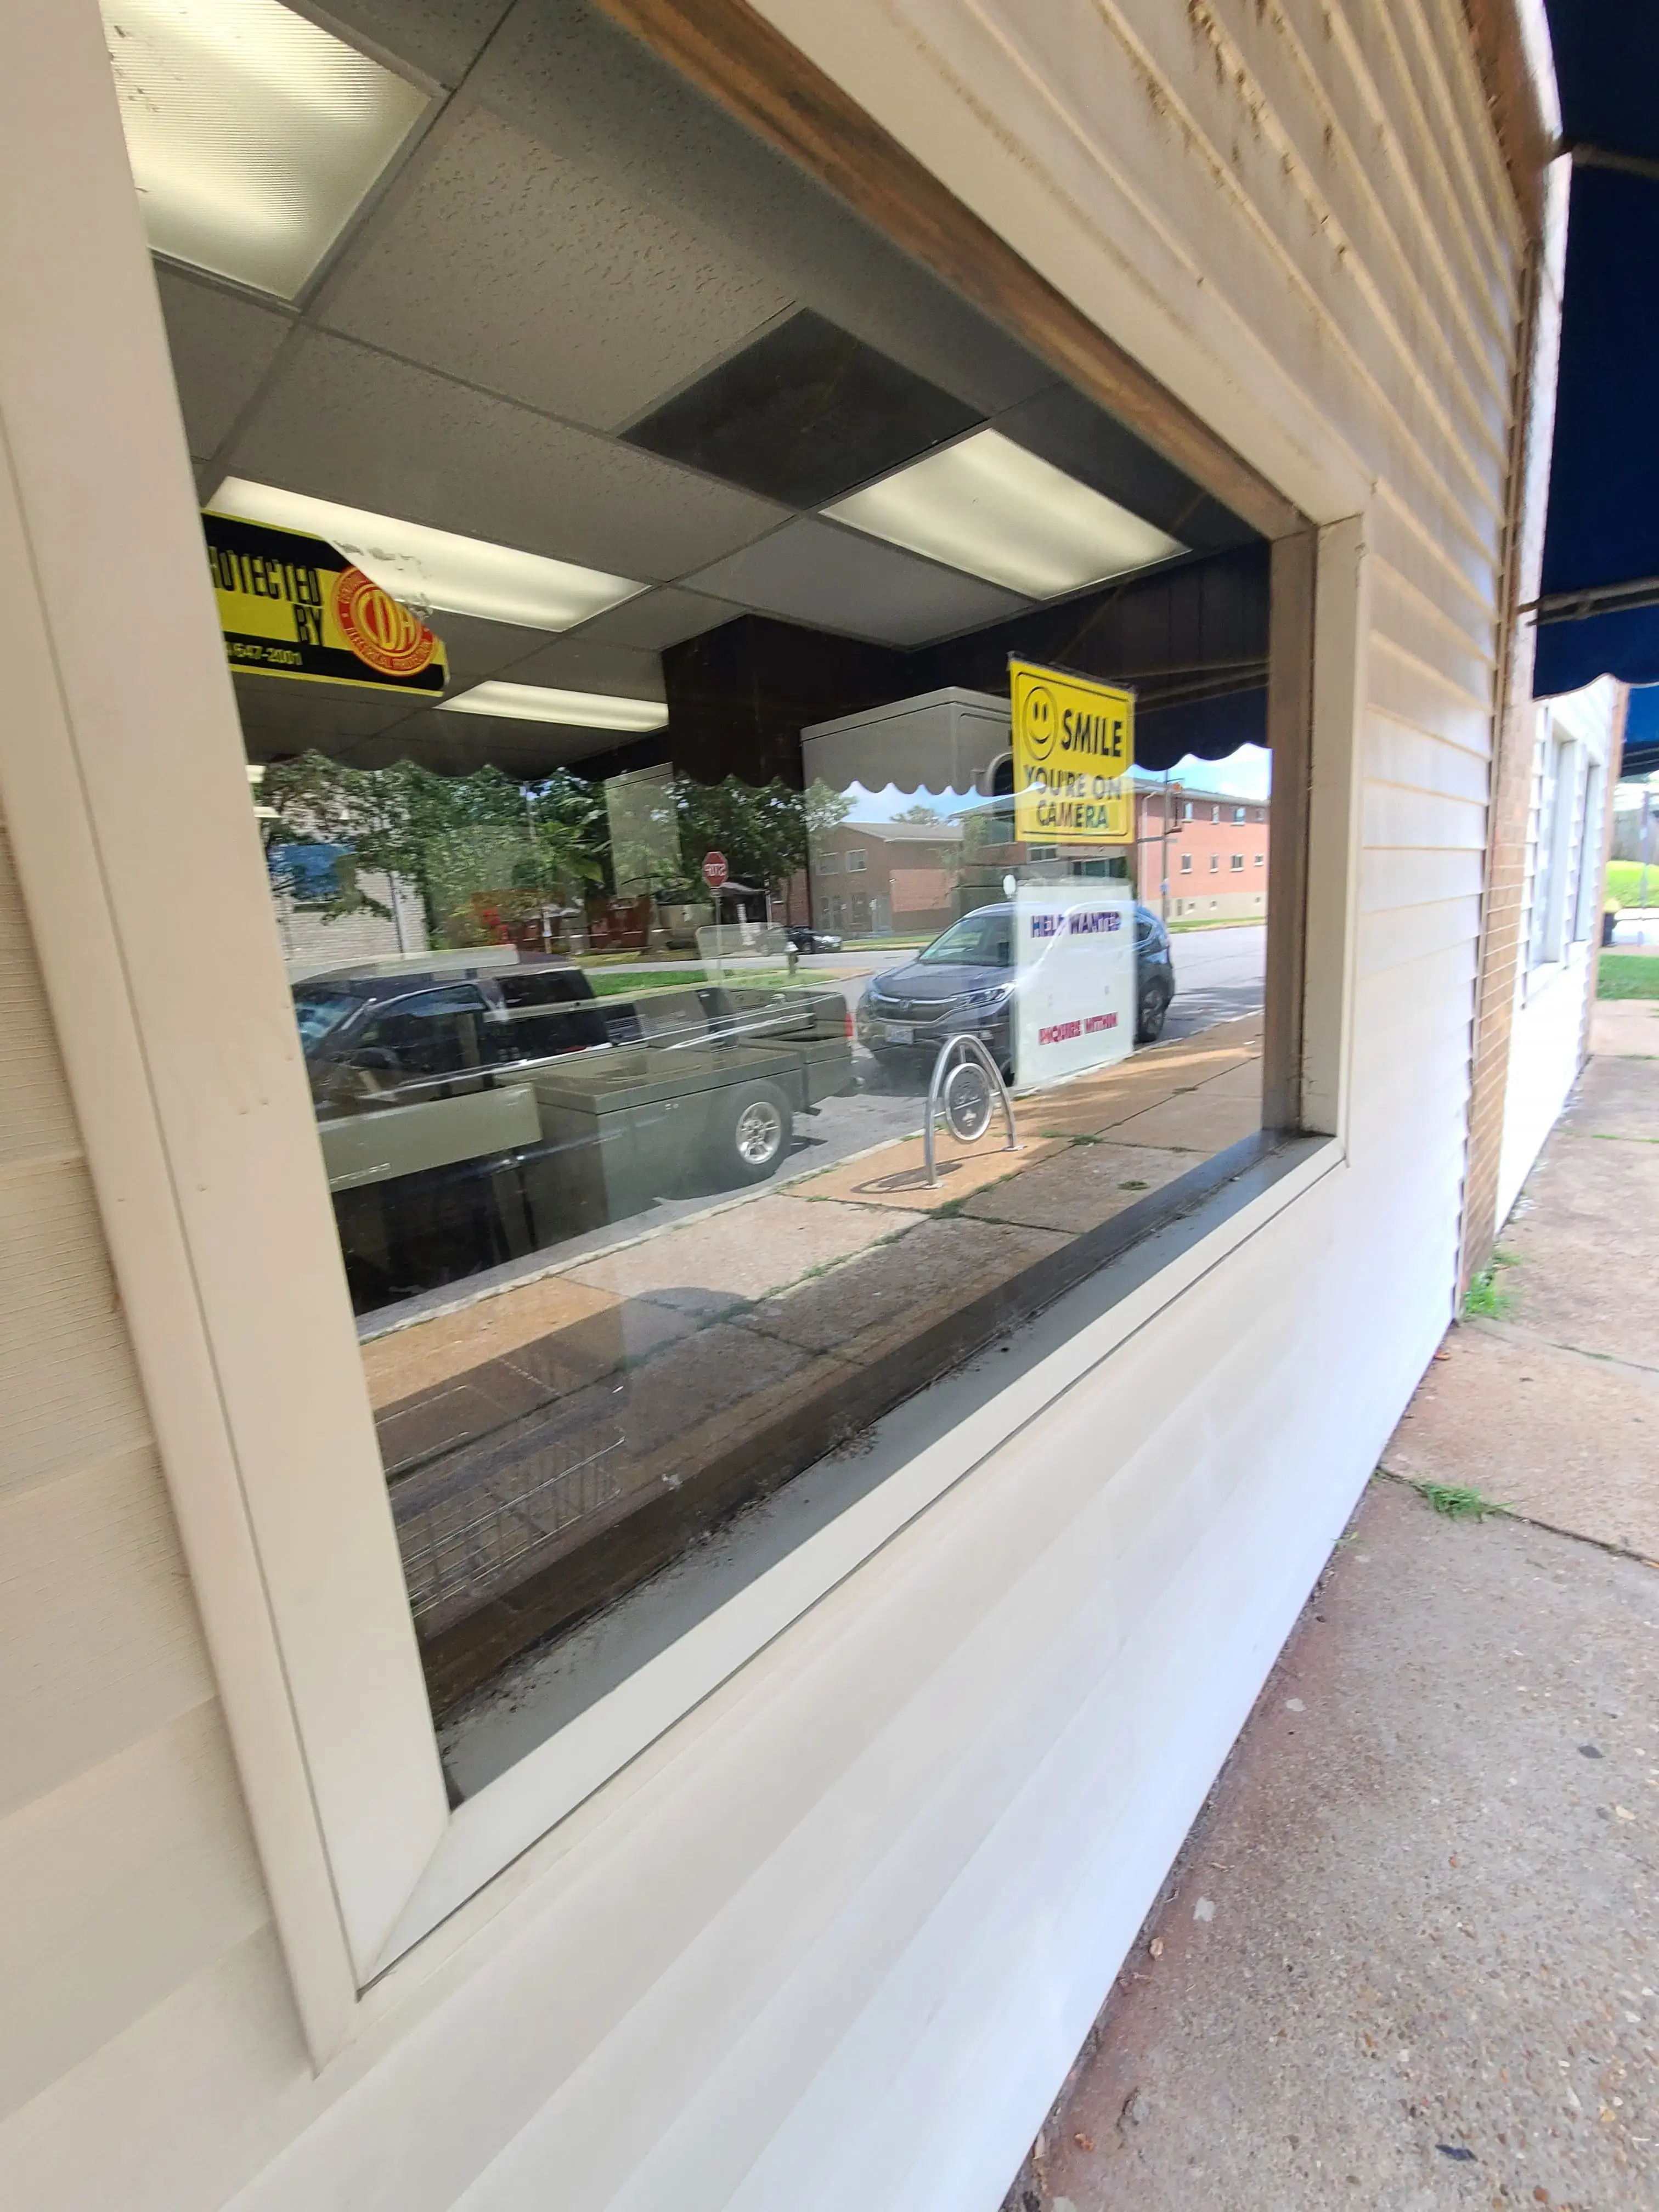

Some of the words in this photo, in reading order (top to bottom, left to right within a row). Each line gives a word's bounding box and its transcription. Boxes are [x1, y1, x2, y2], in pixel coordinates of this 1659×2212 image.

[209, 547, 321, 606] OTECTED
[295, 604, 320, 645] BY
[1061, 709, 1122, 757] SMILE
[1092, 775, 1122, 800] ON
[1036, 799, 1109, 828] CAMERA
